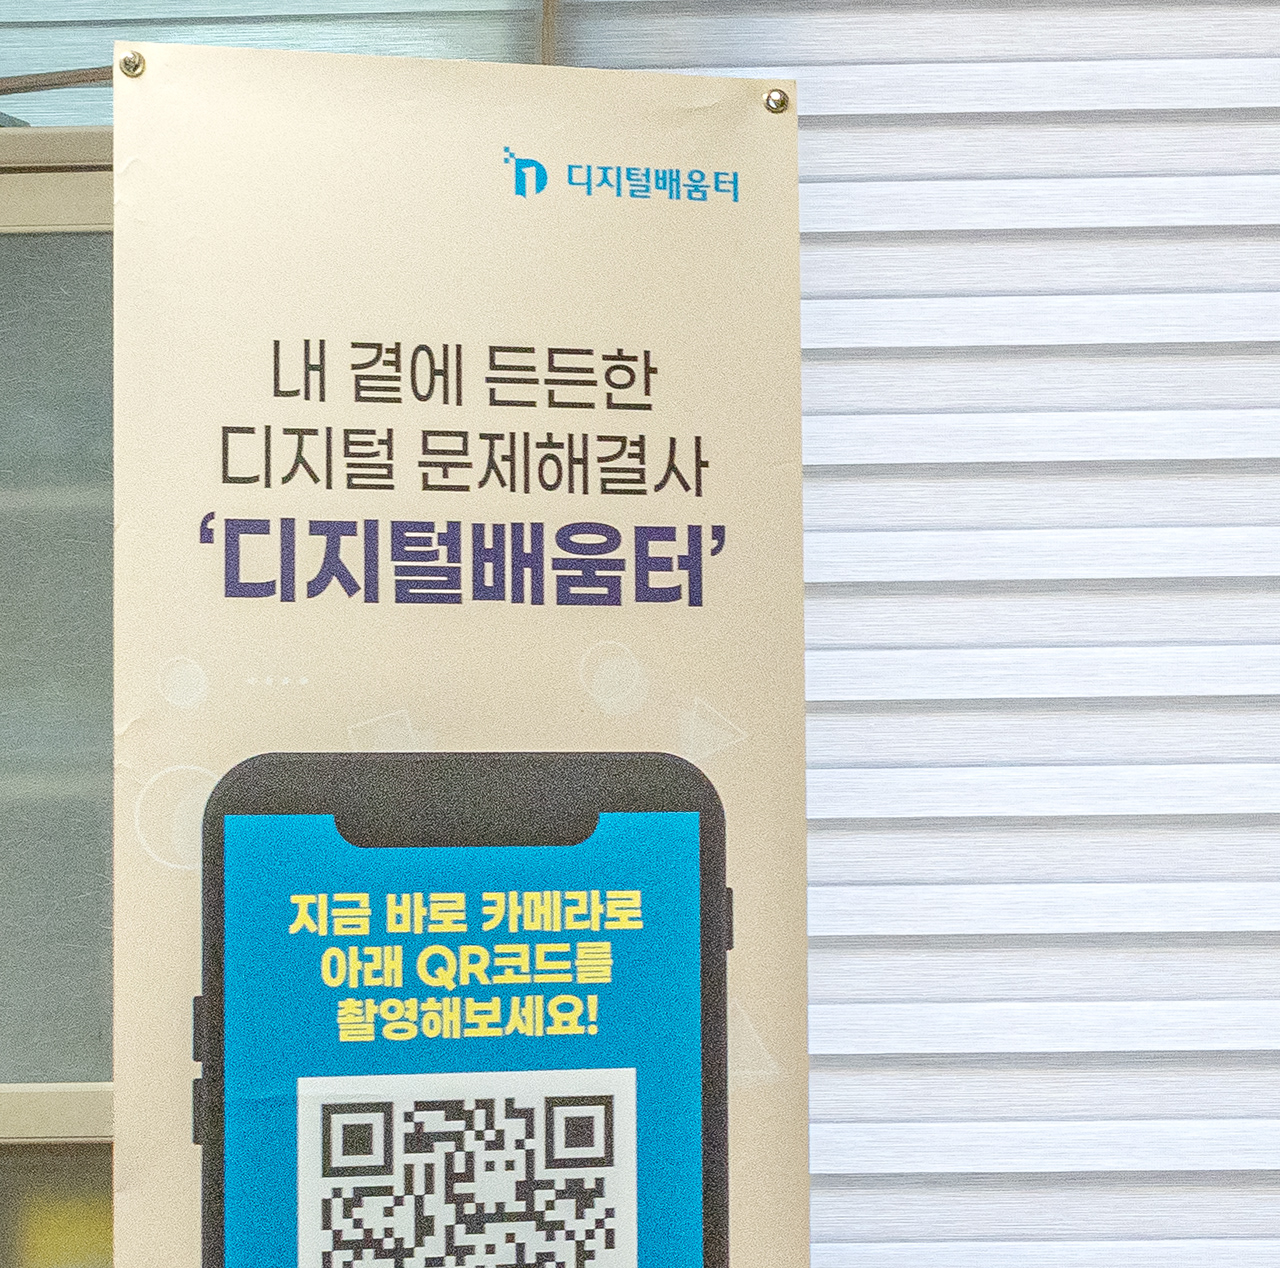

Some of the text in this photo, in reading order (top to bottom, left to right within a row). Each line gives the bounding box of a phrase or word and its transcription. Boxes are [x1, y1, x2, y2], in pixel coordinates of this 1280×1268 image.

[567, 163, 741, 203] 디지털배움터
[271, 338, 659, 411] 내 곁에 든든한
[220, 425, 710, 497] 디지털 문제해결사
[288, 889, 645, 936] 지금 바로 카메라로
[320, 941, 614, 991] 아래 QR코드를
[336, 994, 600, 1043] 촬영해보세요!
